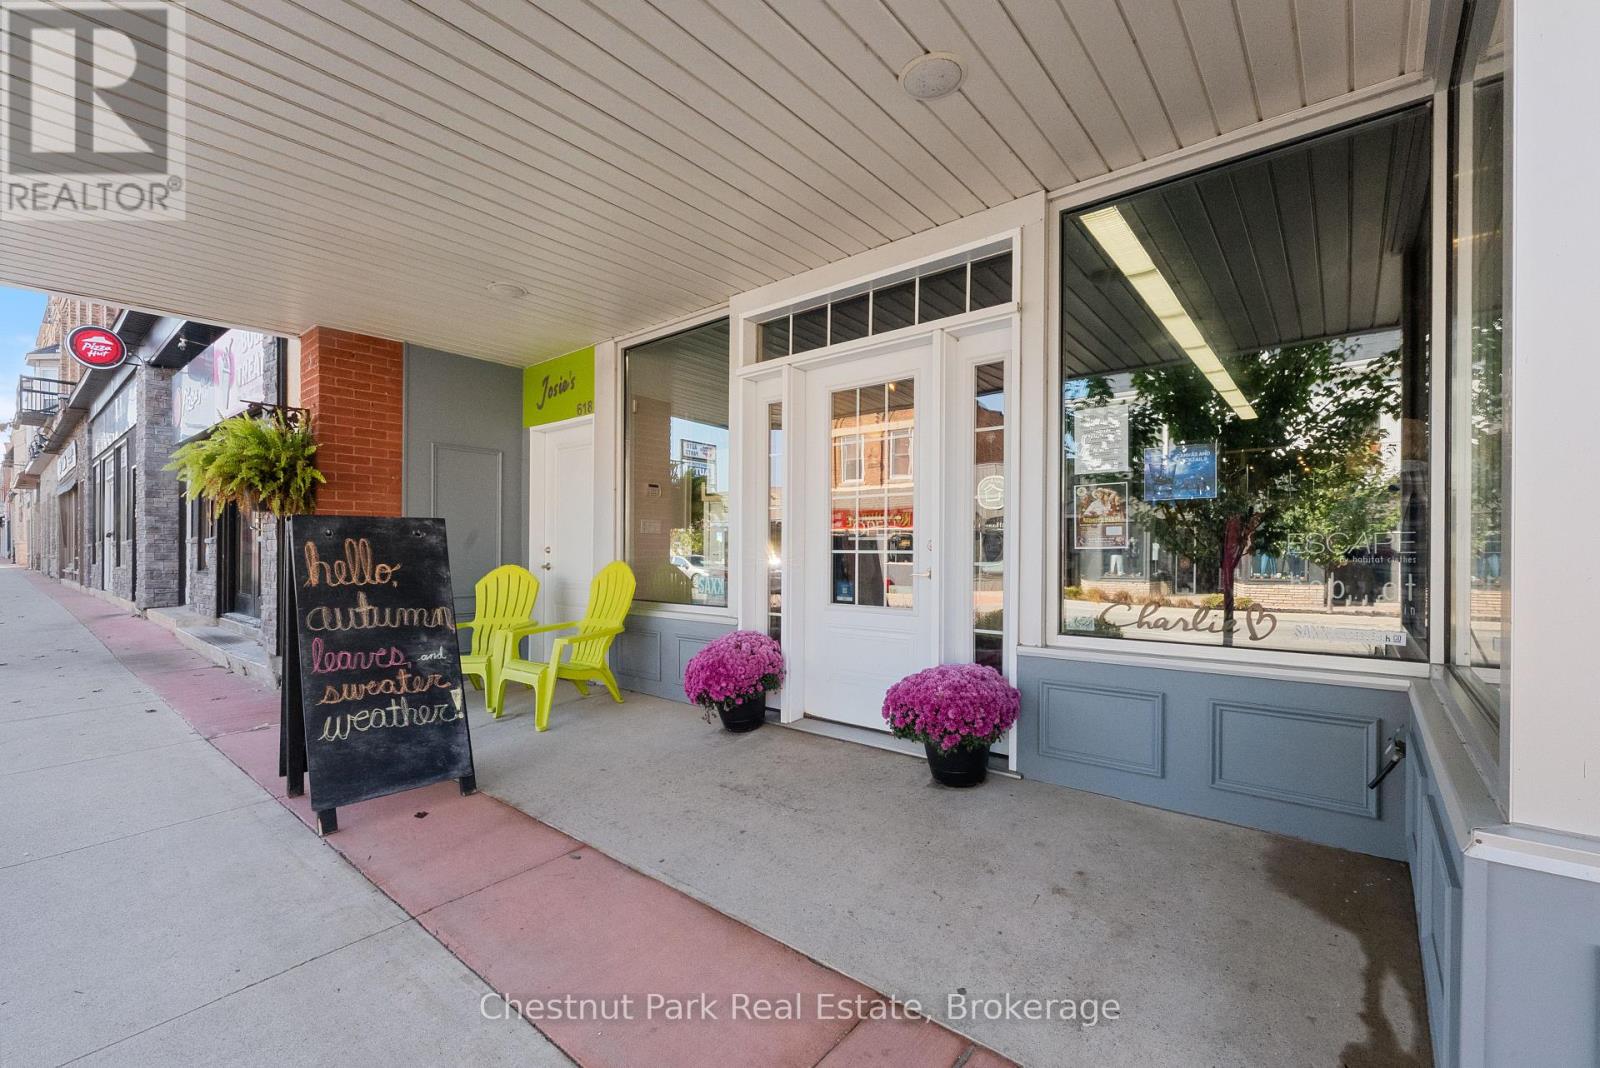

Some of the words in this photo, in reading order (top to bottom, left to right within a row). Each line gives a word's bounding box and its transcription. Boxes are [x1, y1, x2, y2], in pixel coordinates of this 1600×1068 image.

[82, 342, 112, 351] Pizza
[536, 370, 576, 410] Josie's
[577, 400, 592, 416] 618
[1287, 531, 1417, 554] ESCAPE
[1352, 555, 1383, 564] habitat
[1100, 602, 1240, 633] Charlie
[417, 646, 447, 661] and
[315, 669, 451, 706] sweater
[317, 688, 464, 741] weather!
